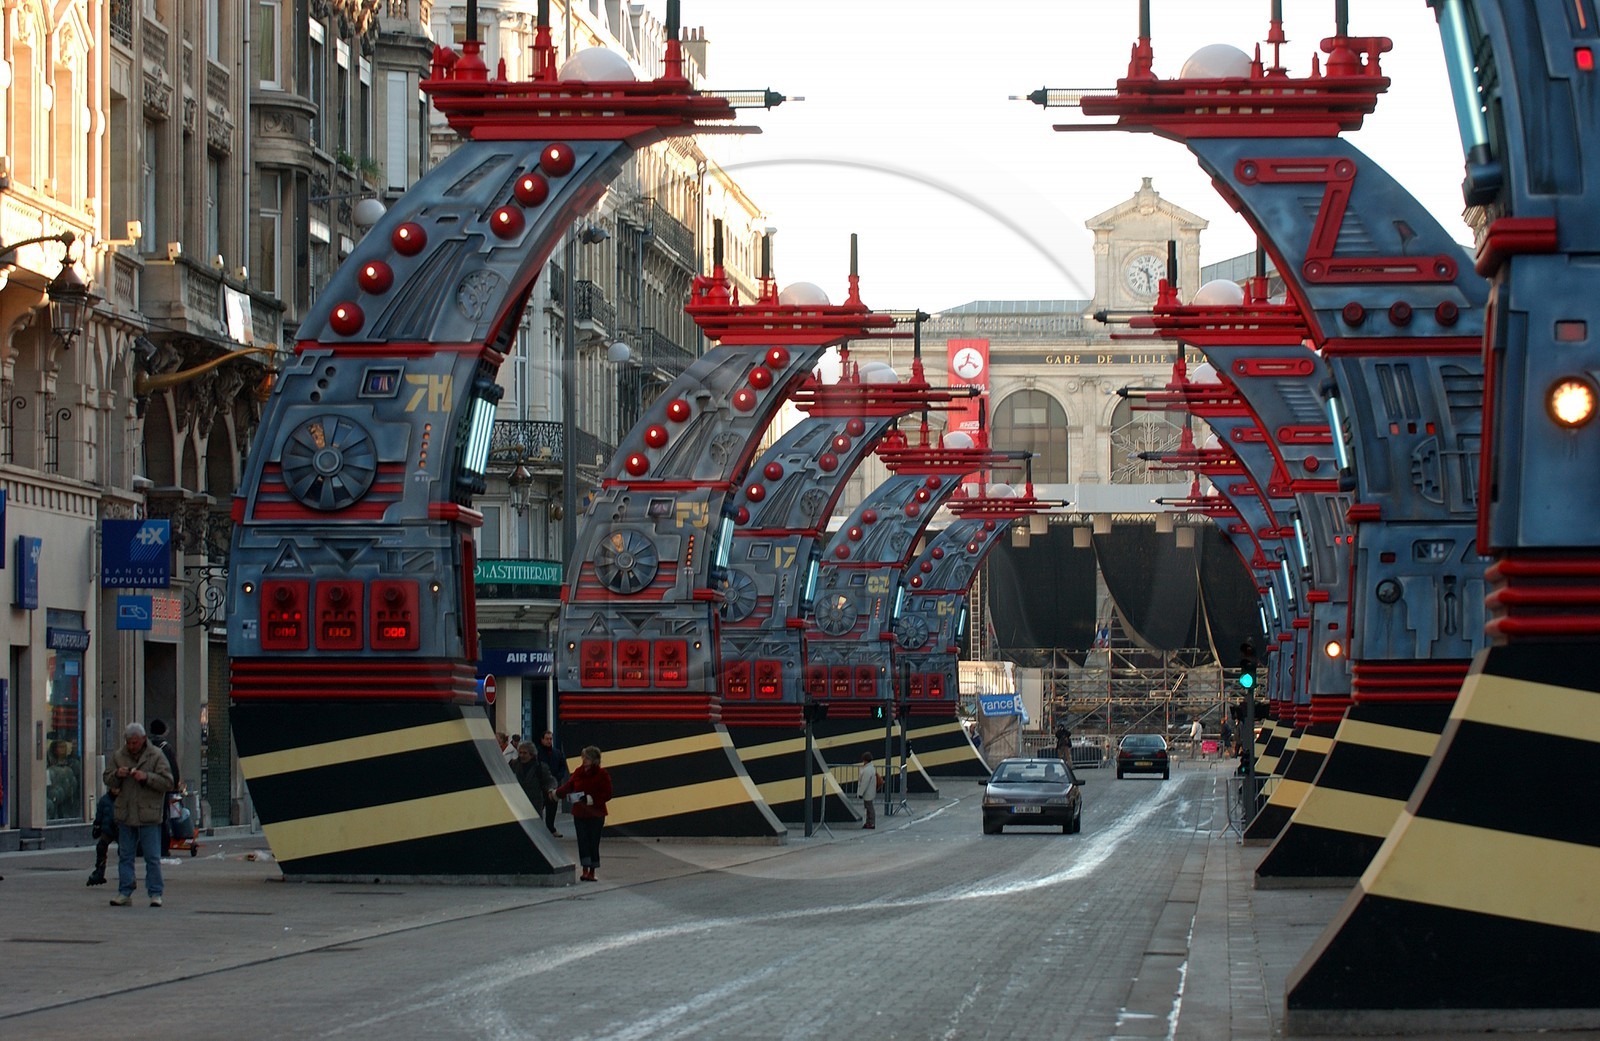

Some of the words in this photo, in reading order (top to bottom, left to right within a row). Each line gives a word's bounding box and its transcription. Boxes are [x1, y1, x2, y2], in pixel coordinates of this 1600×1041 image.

[1045, 354, 1081, 363] GARE
[1097, 354, 1113, 363] DE
[1130, 354, 1167, 363] LILLE
[105, 567, 164, 575] BANQUE
[506, 652, 527, 663] AIR
